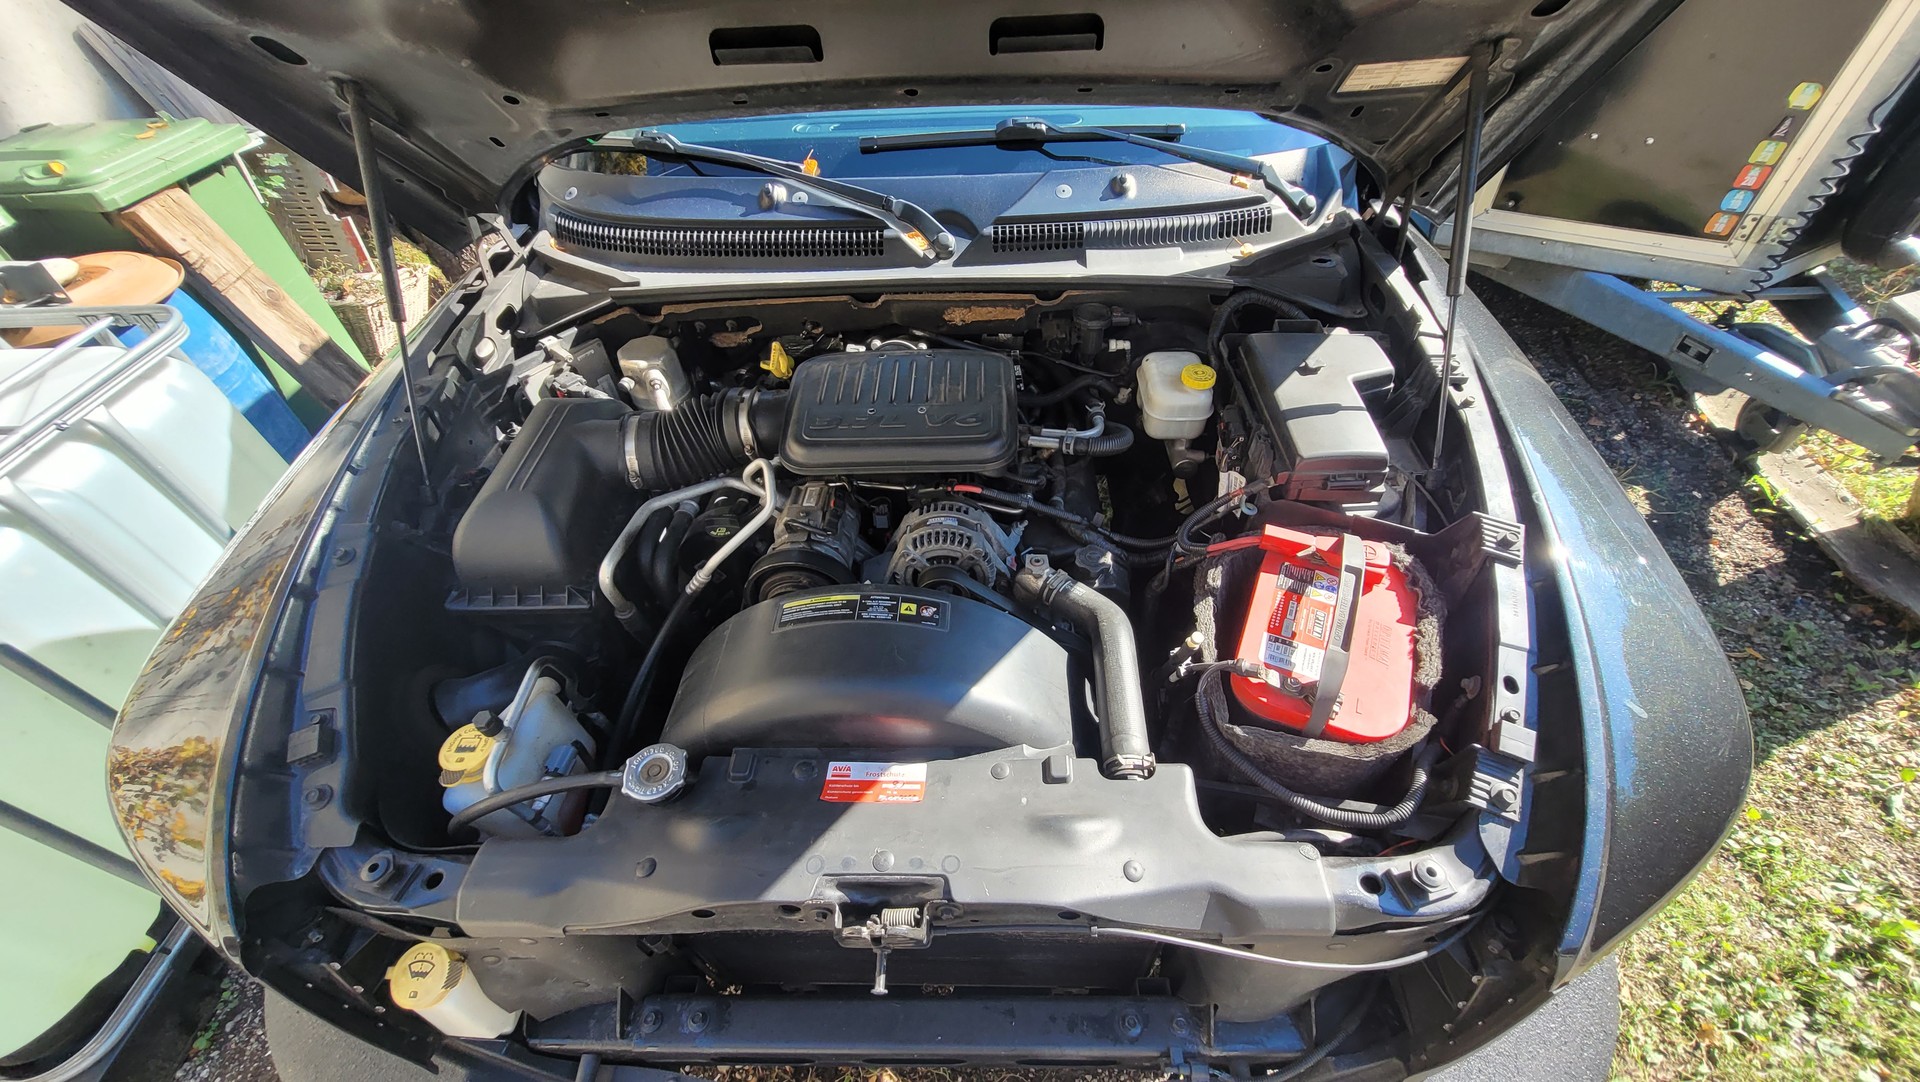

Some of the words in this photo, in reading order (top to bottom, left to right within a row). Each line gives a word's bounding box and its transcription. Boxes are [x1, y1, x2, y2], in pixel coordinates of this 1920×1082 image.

[924, 413, 984, 427] V6
[1313, 610, 1325, 639] OPTIMA
[1377, 624, 1392, 666] OPTIMA
[831, 764, 852, 772] AVIA
